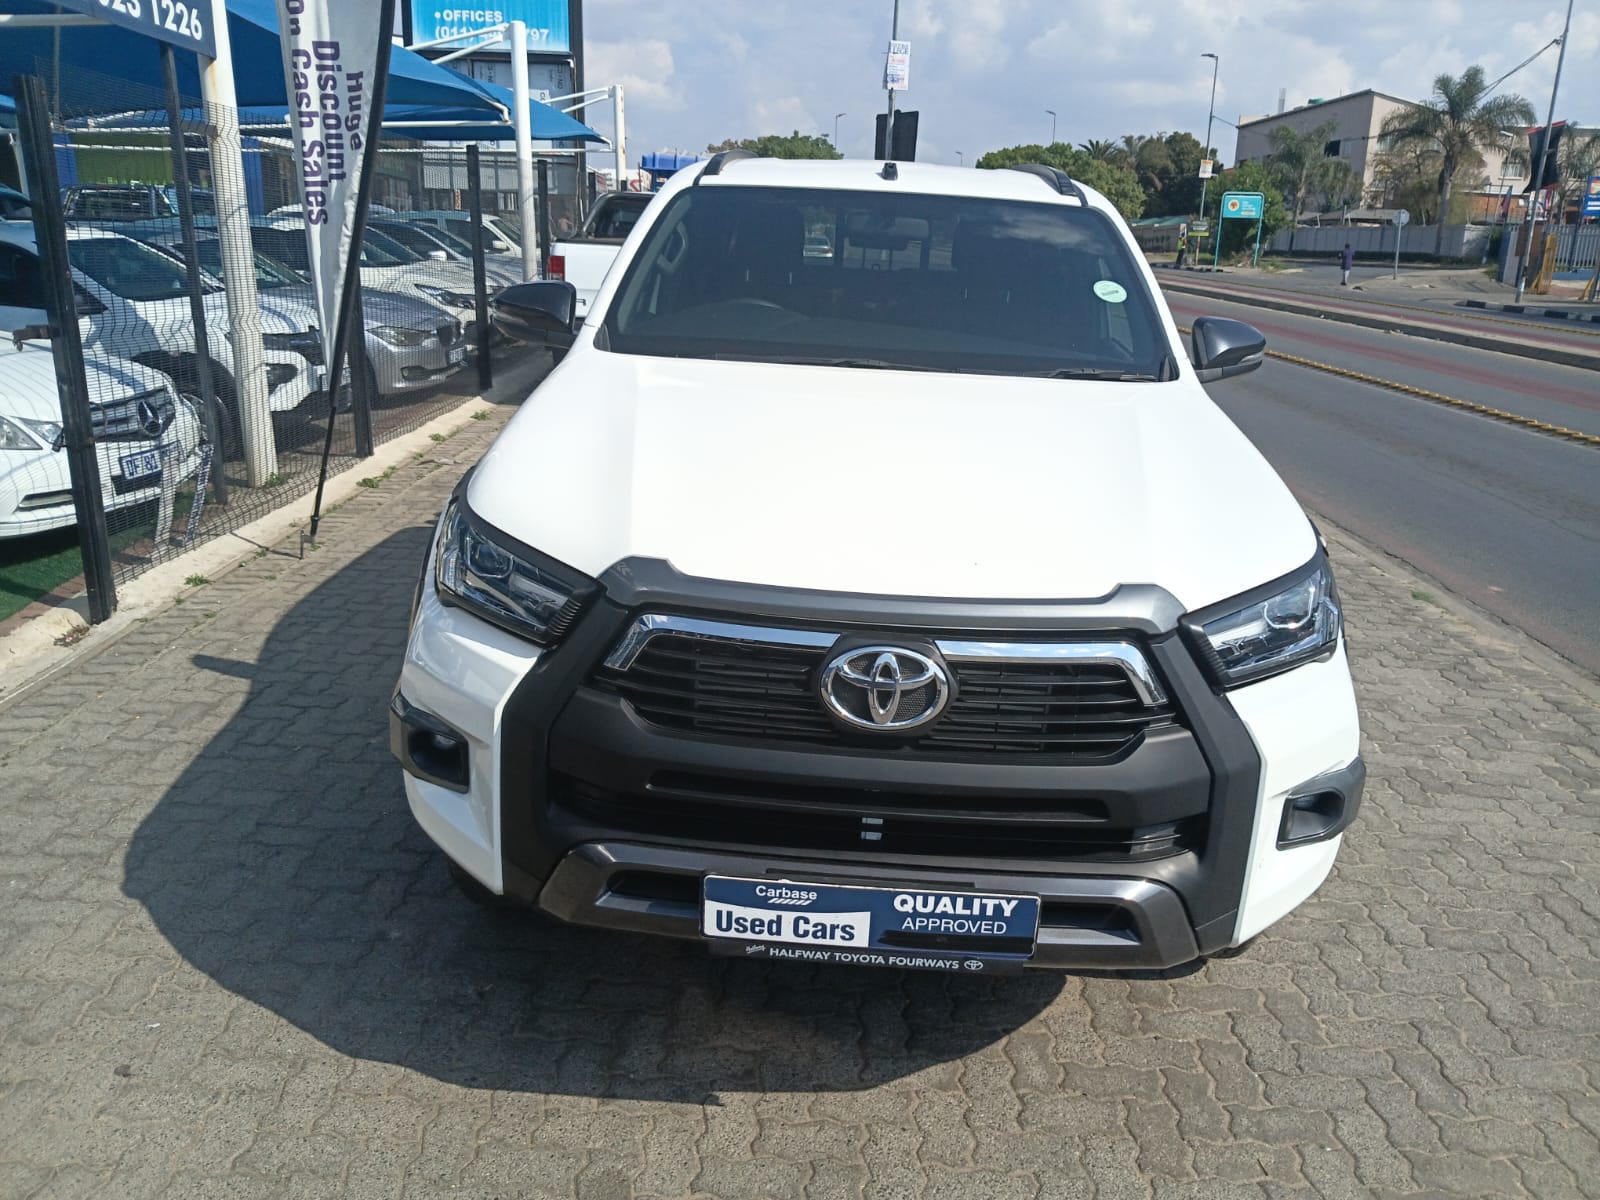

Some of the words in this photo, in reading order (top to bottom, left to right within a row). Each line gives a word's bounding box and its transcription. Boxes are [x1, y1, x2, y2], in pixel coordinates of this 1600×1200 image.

[151, 0, 203, 41] 1226
[442, 9, 504, 23] OFFICES
[291, 48, 320, 129] Cash
[312, 40, 347, 183] Discount
[345, 70, 364, 151] Huge
[301, 139, 329, 226] Sales
[755, 885, 818, 901] Carbase
[893, 893, 1019, 918] QUALITY
[715, 909, 783, 937] Used
[792, 915, 856, 942] Cars
[901, 917, 1007, 935] APPROVED
[769, 948, 832, 961] HALFWAY
[833, 952, 886, 965] TOYOTA
[888, 956, 960, 969] FOURWAYS
